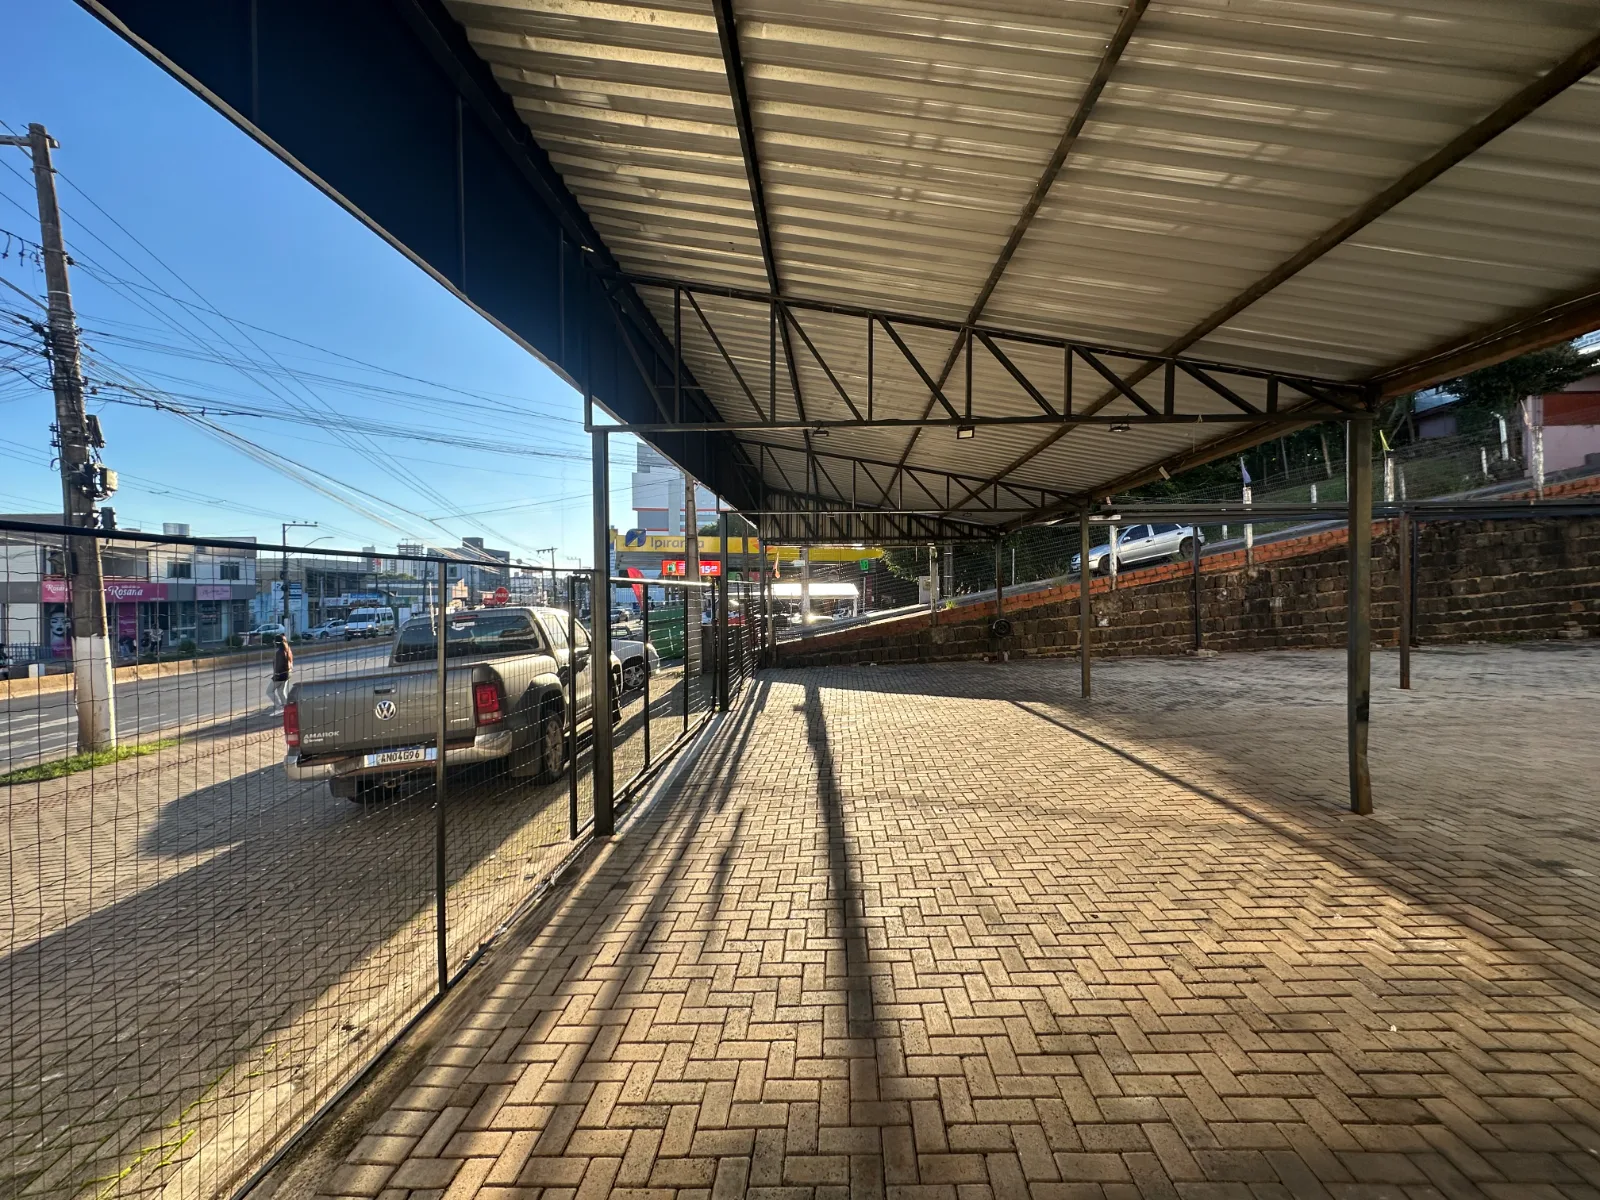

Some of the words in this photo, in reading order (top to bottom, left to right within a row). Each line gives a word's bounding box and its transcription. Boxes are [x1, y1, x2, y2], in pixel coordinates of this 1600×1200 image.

[650, 536, 705, 550] Ipirana
[107, 585, 144, 600] Rosana
[303, 730, 340, 739] AMAROK
